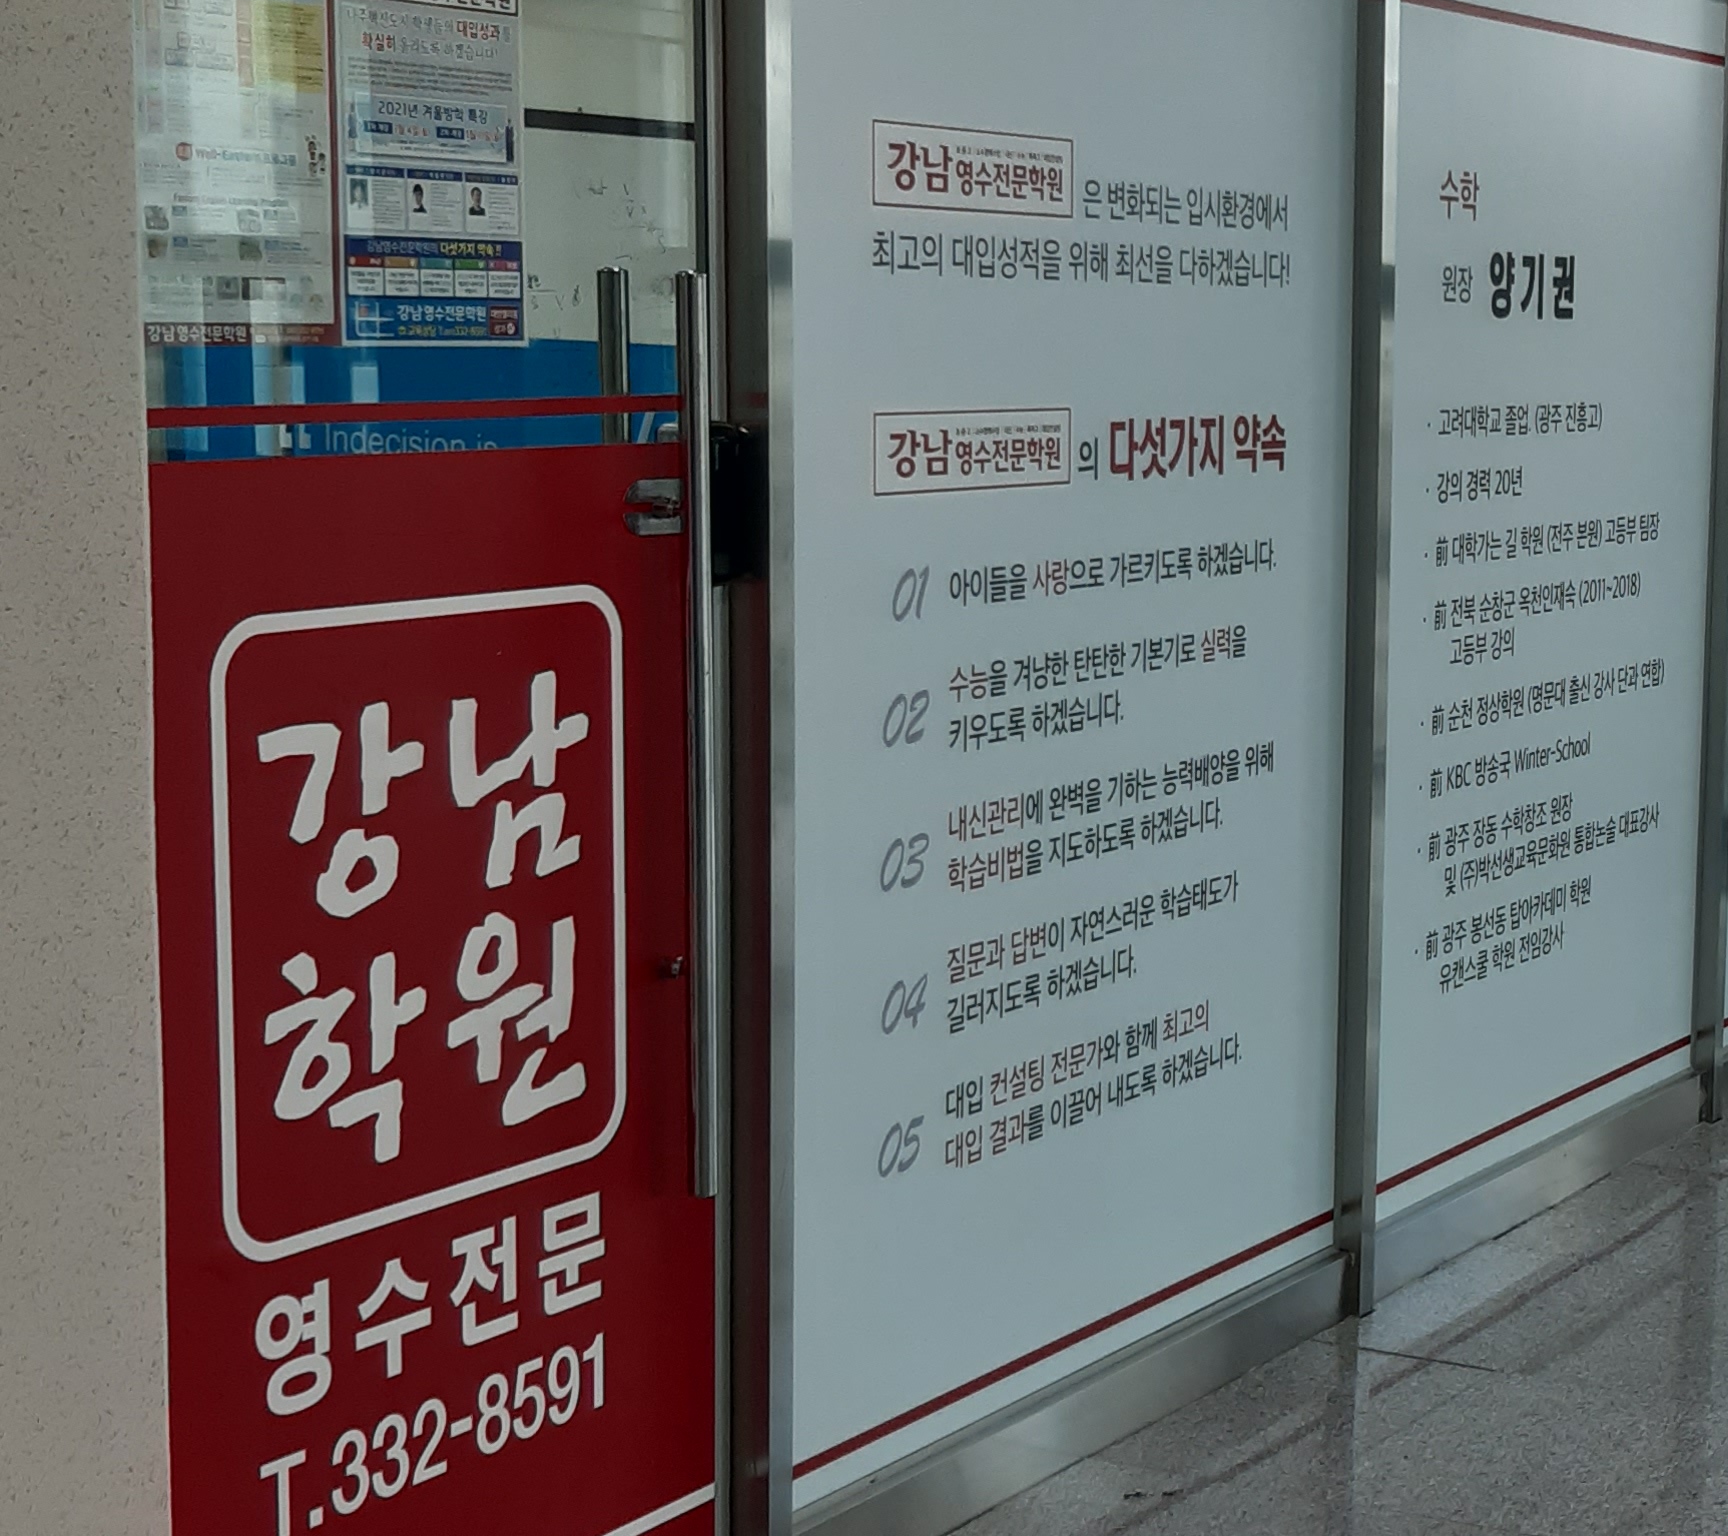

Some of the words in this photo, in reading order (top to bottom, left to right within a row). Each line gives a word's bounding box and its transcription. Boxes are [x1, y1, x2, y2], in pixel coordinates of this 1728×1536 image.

[378, 101, 418, 119] 2021년
[887, 141, 952, 193] 강남
[956, 160, 1063, 202] 영수전문학원
[1084, 180, 1102, 219] 은
[1107, 182, 1182, 224] 변화되는
[1186, 189, 1289, 231] 입시환경에서
[1440, 169, 1480, 221] 수학
[872, 231, 943, 276] 최고의
[951, 234, 1062, 281] 대입성적을
[1068, 244, 1109, 284] 위해
[1115, 243, 1173, 285] 최선을
[1179, 249, 1290, 288] 다하겠습니다!
[1441, 265, 1473, 304] 원장
[1489, 251, 1576, 320] 양기권
[147, 325, 175, 342] 강남
[176, 325, 248, 342] 영수전문학원
[397, 304, 423, 321] 강남
[424, 305, 487, 322] 영수전문학원
[887, 429, 952, 478] 강남
[955, 437, 1061, 475] 영수전문학원
[1079, 437, 1099, 480] 의
[1109, 414, 1225, 481] 다섯가지
[1233, 413, 1287, 471] 약속
[1438, 406, 1502, 438] 고려대학교
[1535, 404, 1562, 434] (광주
[1565, 402, 1603, 432] 진흥고)
[1437, 469, 1463, 503] 강의
[1466, 467, 1491, 501] 경력
[1494, 465, 1523, 497] 20년
[1452, 531, 1502, 564] 대학가는
[1505, 528, 1518, 560] 길
[1520, 524, 1544, 556] 학원
[1547, 522, 1573, 554] (전주
[1577, 518, 1603, 549] 본원)
[1605, 515, 1636, 544] 고등부
[1639, 512, 1660, 541] 팀장
[892, 565, 930, 622] 01
[950, 563, 1027, 607] 아이들을
[1032, 557, 1105, 597] 사랑으로
[1109, 547, 1192, 588] 가르키도록
[1197, 538, 1276, 577] 하겠습니다.
[1450, 594, 1476, 628] 전북
[1479, 589, 1515, 624] 순창군
[1579, 571, 1641, 607] (2011~2018)
[949, 659, 1008, 703] 수능을
[1013, 651, 1069, 693] 겨냥한
[1073, 641, 1126, 682] 탄탄한
[1131, 634, 1196, 673] 기본기로
[1200, 624, 1247, 663] 실력을
[1450, 632, 1487, 665] 고등부
[1490, 627, 1515, 660] 강의
[882, 689, 930, 748] 02
[948, 705, 1026, 753] 키우도록
[1031, 689, 1124, 735] 하겠습니다.
[1448, 698, 1472, 733] 순천
[1476, 686, 1524, 726] 정상학원
[1528, 677, 1566, 715] (명문대
[1569, 671, 1591, 706] 출신
[1594, 667, 1615, 699] 강사
[1617, 662, 1638, 693] 단과
[257, 670, 589, 918] 강남
[948, 788, 1043, 843] 내신관리에
[1048, 778, 1101, 821] 완벽을
[1107, 766, 1157, 803] 기하는
[1162, 748, 1240, 797] 능력배양을
[1244, 741, 1275, 776] 위해
[1446, 761, 1472, 792] KBC
[1474, 750, 1511, 787] 방송국
[1514, 731, 1591, 774] Winter-School
[947, 837, 1043, 893] 학습비법을
[1048, 817, 1135, 867] 지도하도록
[1140, 797, 1224, 842] 하겠습니다.
[1444, 822, 1470, 857] 광주
[1473, 814, 1497, 849] 장동
[1501, 801, 1547, 840] 수학창조
[1550, 792, 1573, 825] 원장
[1444, 866, 1456, 897] 및
[1460, 828, 1571, 891] (주)박선생교육문화원
[1574, 816, 1616, 855] 통합논술
[1619, 801, 1660, 838] 대표강사
[879, 832, 930, 892] 03
[947, 935, 1004, 984] 질문과
[1010, 917, 1065, 967] 답변이
[1069, 894, 1155, 946] 자연스러운
[1160, 870, 1238, 920] 학습태도가
[1442, 919, 1467, 955] 광주
[1471, 905, 1506, 945] 봉선동
[1510, 884, 1566, 930] 탑아카데미
[1570, 875, 1591, 908] 학원
[1492, 938, 1515, 972] 학원
[1518, 921, 1564, 964] 전임강사
[881, 973, 928, 1035] 04
[946, 974, 1041, 1034] 길러지도록
[1046, 944, 1137, 999] 하겠습니다.
[265, 911, 587, 1164] 학원
[945, 1075, 984, 1120] 대입
[989, 1055, 1045, 1107] 컨설팅
[1050, 1030, 1121, 1085] 전문가와
[1124, 1015, 1157, 1053] 함께
[1162, 1000, 1210, 1043] 최고의
[945, 1124, 982, 1169] 대입
[989, 1104, 1044, 1156] 결과를
[1050, 1080, 1101, 1130] 이끌어
[1107, 1063, 1157, 1109] 내도록
[1161, 1032, 1242, 1088] 하겠습니다.
[877, 1115, 925, 1178] 05
[254, 1191, 607, 1417] 영수전문
